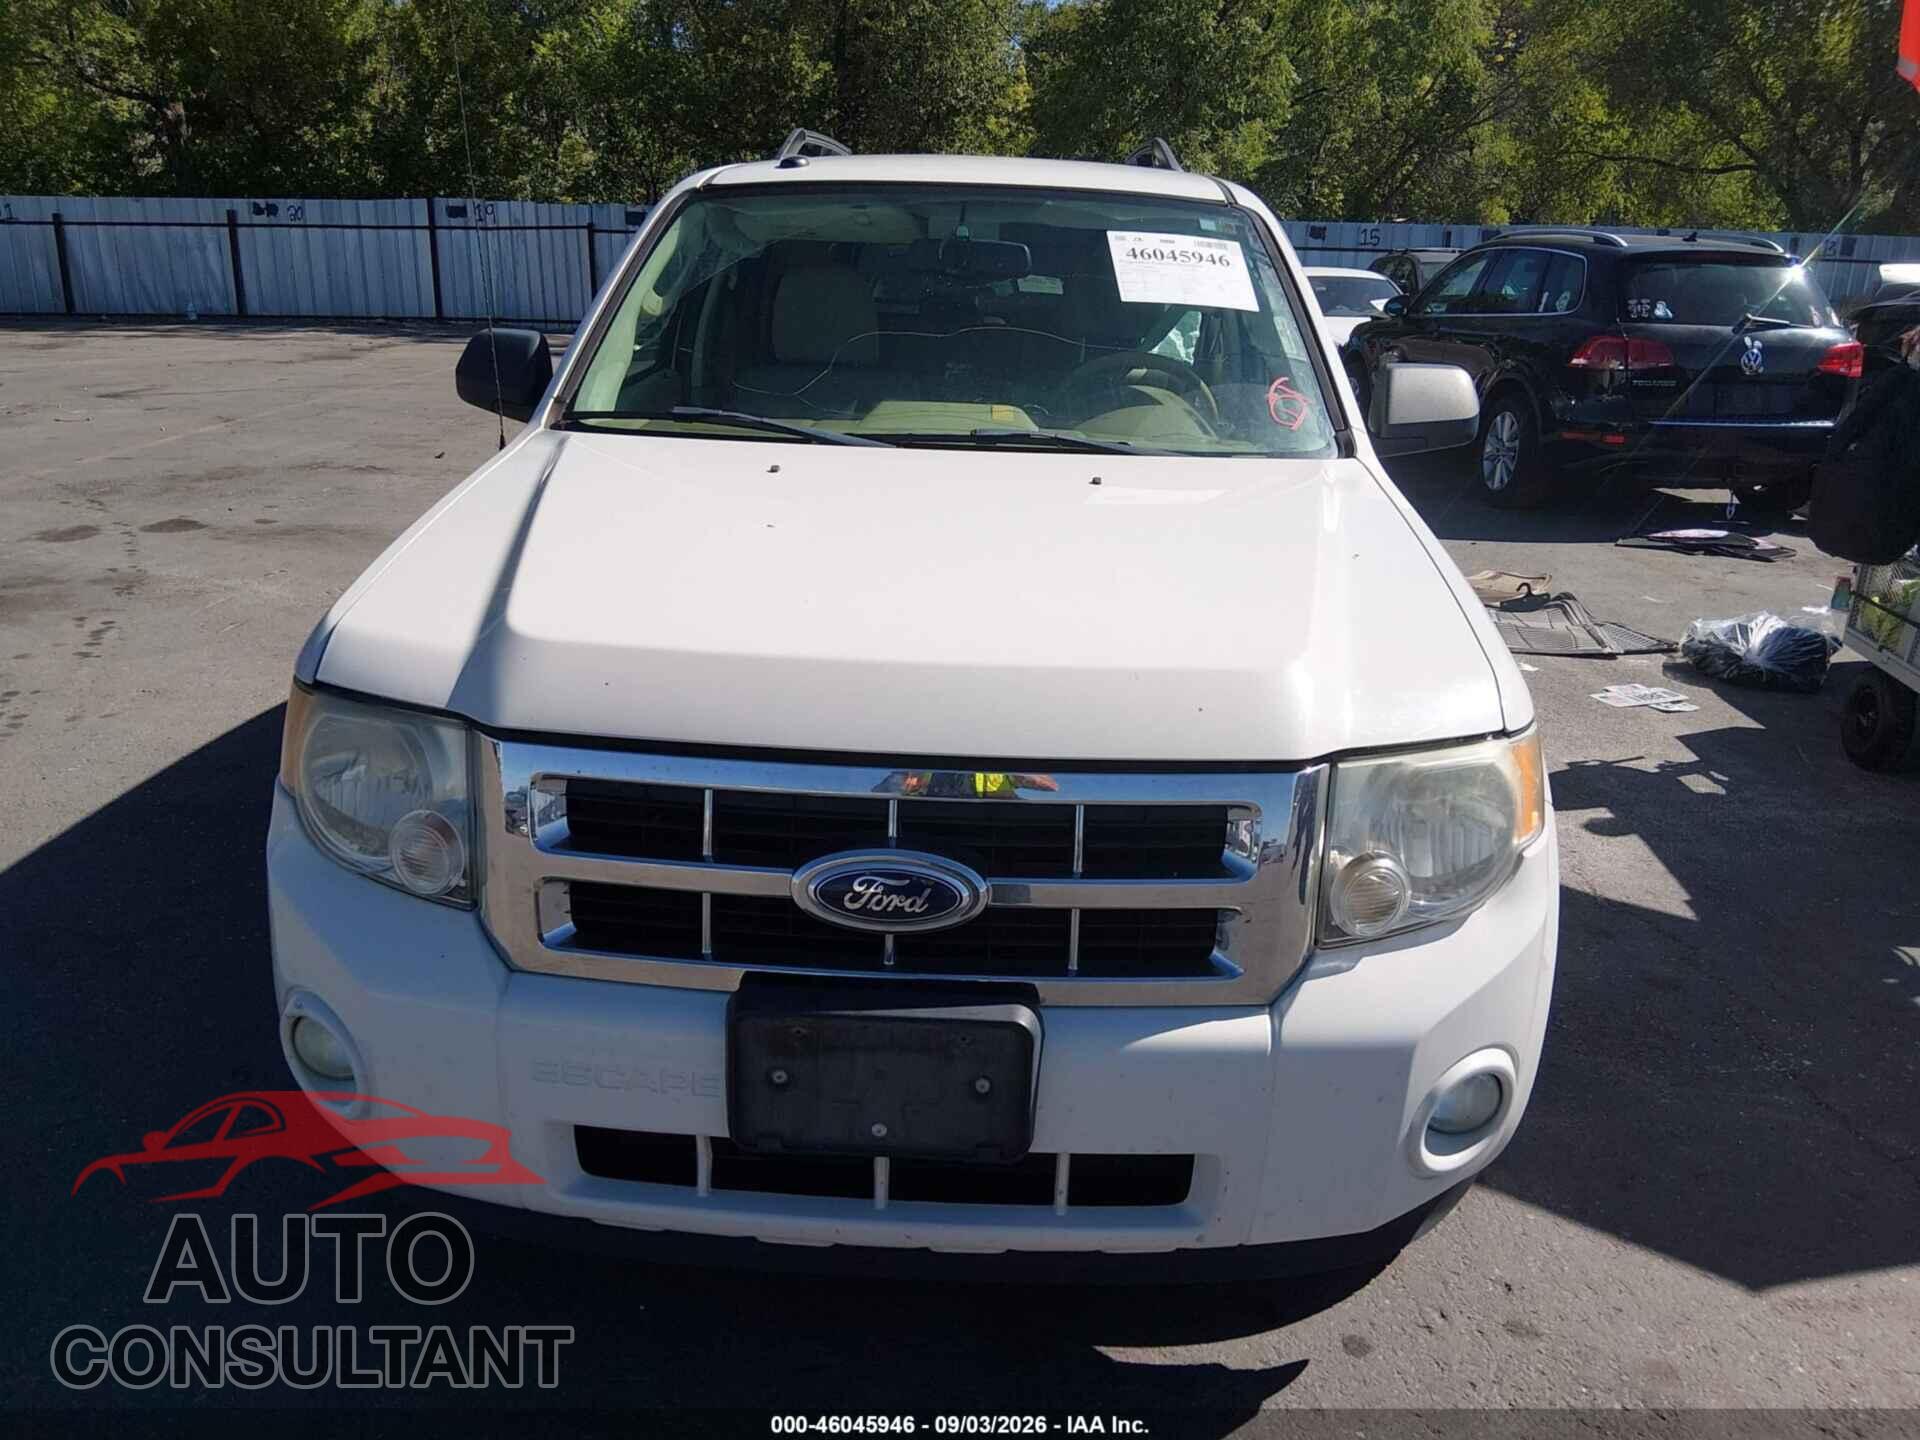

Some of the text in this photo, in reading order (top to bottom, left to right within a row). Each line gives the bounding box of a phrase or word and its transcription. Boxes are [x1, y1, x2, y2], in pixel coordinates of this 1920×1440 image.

[1359, 228, 1381, 247] 15
[1125, 246, 1231, 268] 46045946
[843, 876, 932, 913] Ford
